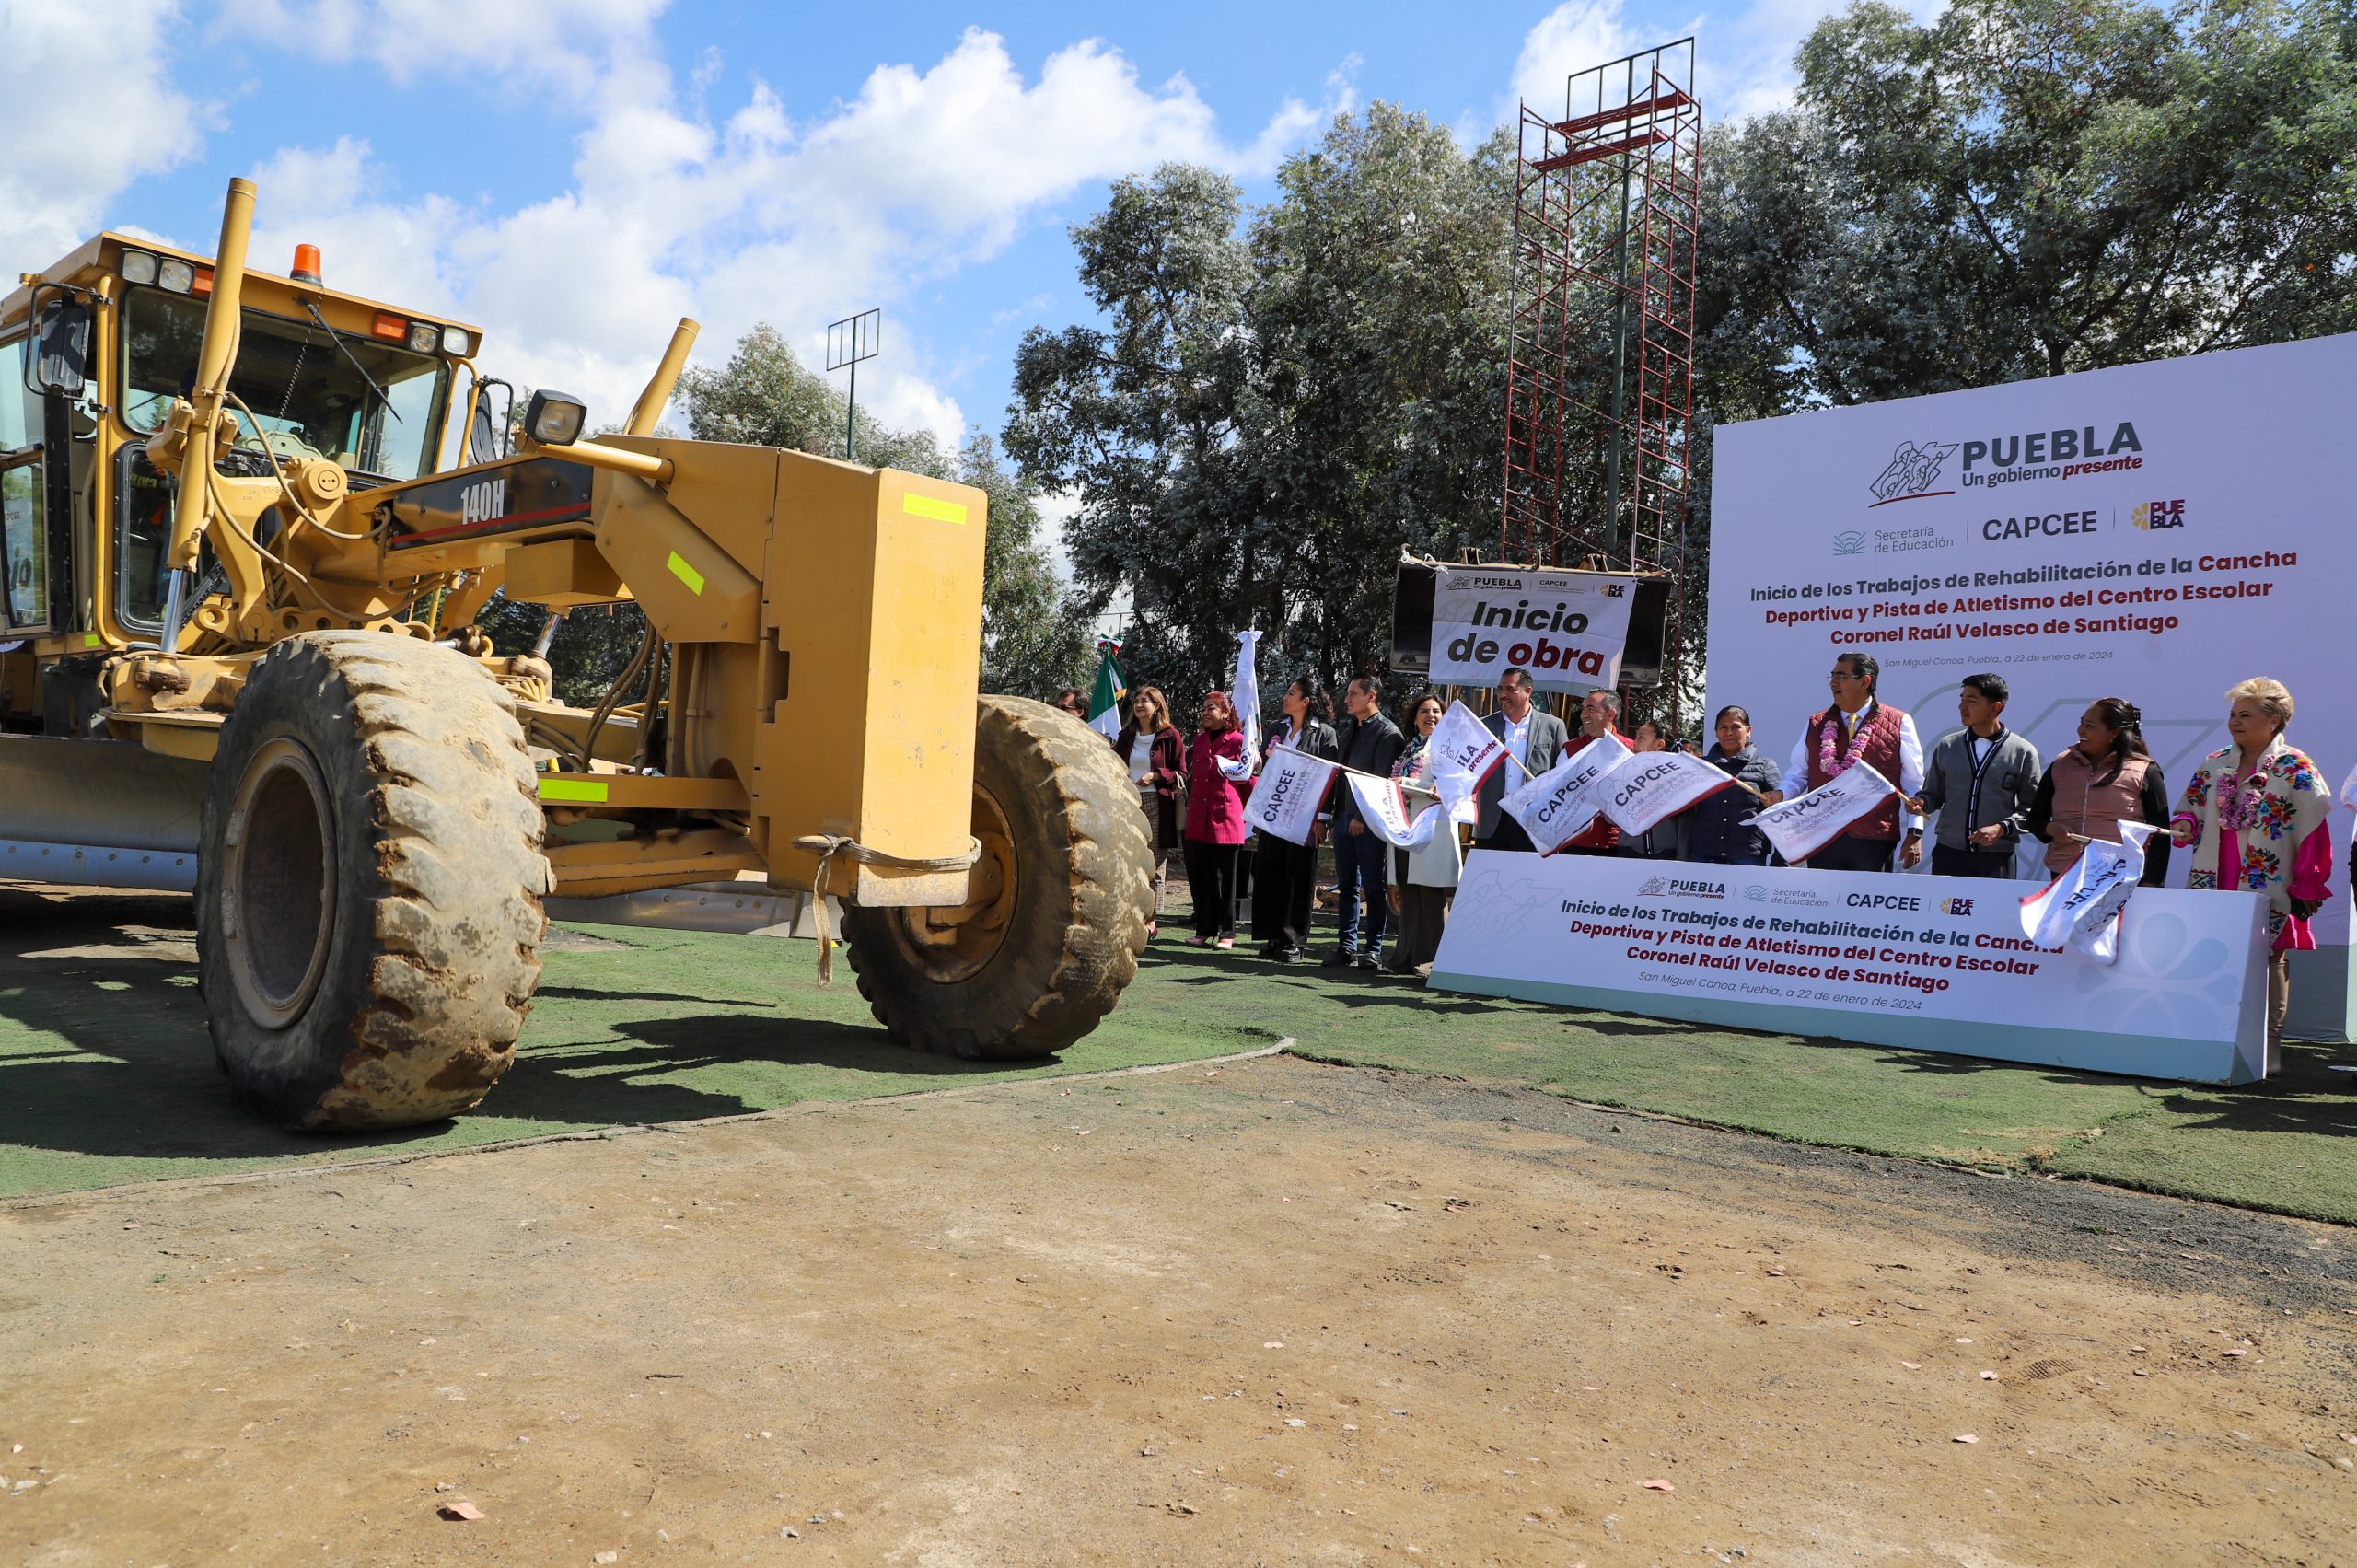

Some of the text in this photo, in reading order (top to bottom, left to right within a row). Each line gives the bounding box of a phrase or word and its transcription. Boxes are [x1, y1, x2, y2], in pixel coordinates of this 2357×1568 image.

[1962, 422, 2142, 471] PUEBLA
[1962, 456, 2143, 488] Un gobierno presente
[460, 478, 505, 525] 140H
[2150, 499, 2185, 516] PUE
[1875, 526, 1934, 541] Secretaría
[1982, 510, 2097, 541] CAPCEE
[2150, 513, 2185, 530] BLA
[1875, 537, 1954, 553] de Educación
[1474, 577, 1522, 587] PUEBLA
[1608, 584, 1625, 592] PUE
[1750, 551, 2297, 601] Inicio de los Trabajos de Rehabilitación de la Cancha
[1608, 590, 1624, 598] BLA
[1765, 580, 2273, 627] Deportiva y Pista de Atletismo del Centro Escolar
[1470, 600, 1589, 635] Inicio
[1830, 613, 2179, 645] Coronel Raúl Velasco de Santiago
[1447, 633, 1605, 677] de obra
[1884, 659, 1900, 668] San
[1902, 657, 1932, 668] Miguel
[2014, 654, 2026, 663] 22
[2027, 654, 2040, 662] de
[2042, 653, 2071, 662] enero
[2073, 652, 2086, 660] de
[2088, 651, 2113, 660] 2024
[1263, 769, 1296, 823] CAPCEE
[1538, 765, 1600, 824] CAPCEE
[1614, 761, 1681, 807] CAPCEE
[1670, 879, 1725, 894] PUEBLA
[1771, 896, 1829, 907] de Educación
[1773, 888, 1817, 899] Secretaría
[1846, 893, 1921, 912] CAPCEE
[1950, 906, 1972, 916] BLA
[1952, 898, 1975, 909] PUE
[1561, 900, 1606, 916] Inicio
[1608, 903, 1630, 918] de
[1632, 905, 1657, 921] los
[1661, 909, 1739, 931] Trabajos
[1742, 915, 1766, 931] de
[1769, 918, 1914, 942] Rehabilitación
[1919, 929, 1945, 946] de
[1950, 930, 1970, 947] la
[1570, 920, 2039, 976] Deportiva y Pista de Atletismo del Centro Escolar
[1627, 947, 1950, 994] Coronel Raúl Velasco de Santiago
[1639, 971, 1659, 982] San
[1661, 974, 1697, 987] Miguel
[1699, 978, 1737, 993] Canoa,
[1786, 988, 1794, 998] a
[1796, 989, 1812, 1000] 22
[1814, 990, 1830, 1002] de
[1832, 993, 1869, 1005] enero
[1871, 995, 1888, 1008] de
[1890, 998, 1922, 1011] 2024
